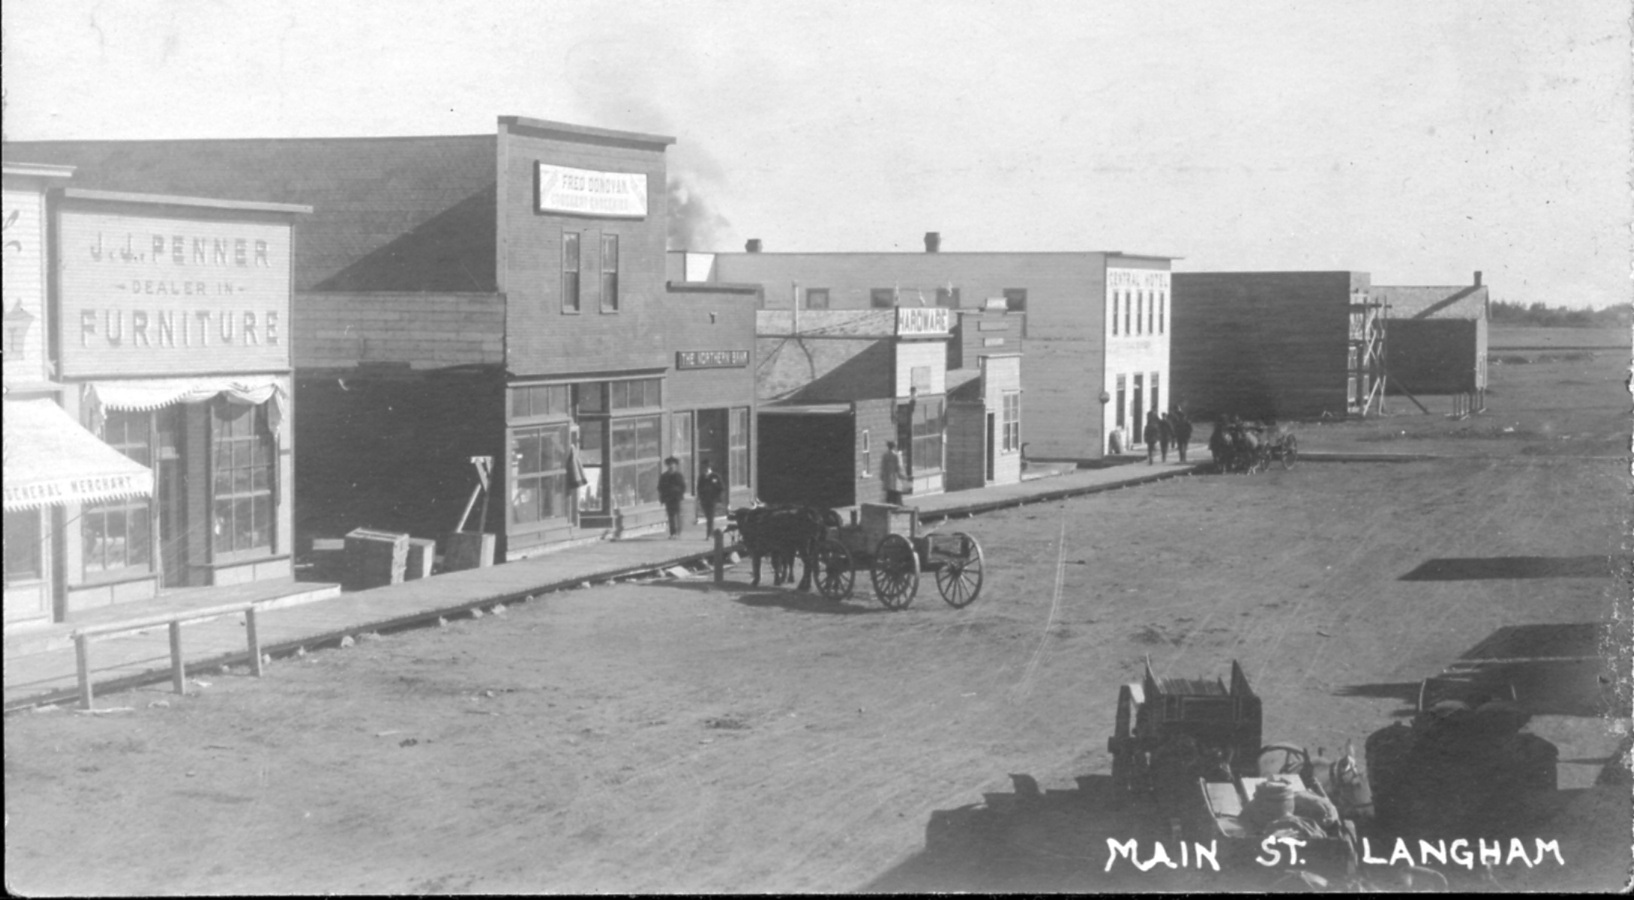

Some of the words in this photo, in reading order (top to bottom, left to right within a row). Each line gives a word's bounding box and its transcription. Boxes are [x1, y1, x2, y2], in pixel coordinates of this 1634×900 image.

[562, 174, 585, 191] FRED
[587, 176, 630, 195] DONOVAN
[152, 234, 270, 268] PENNER
[132, 280, 207, 296] DEALER
[216, 282, 234, 296] IN
[1109, 270, 1140, 287] CENTRAL
[1144, 272, 1169, 288] HOTEL
[80, 308, 280, 349] FURNITURE
[899, 308, 949, 333] HARDWARE
[681, 353, 695, 366] THE
[698, 351, 730, 365] NORTHERN
